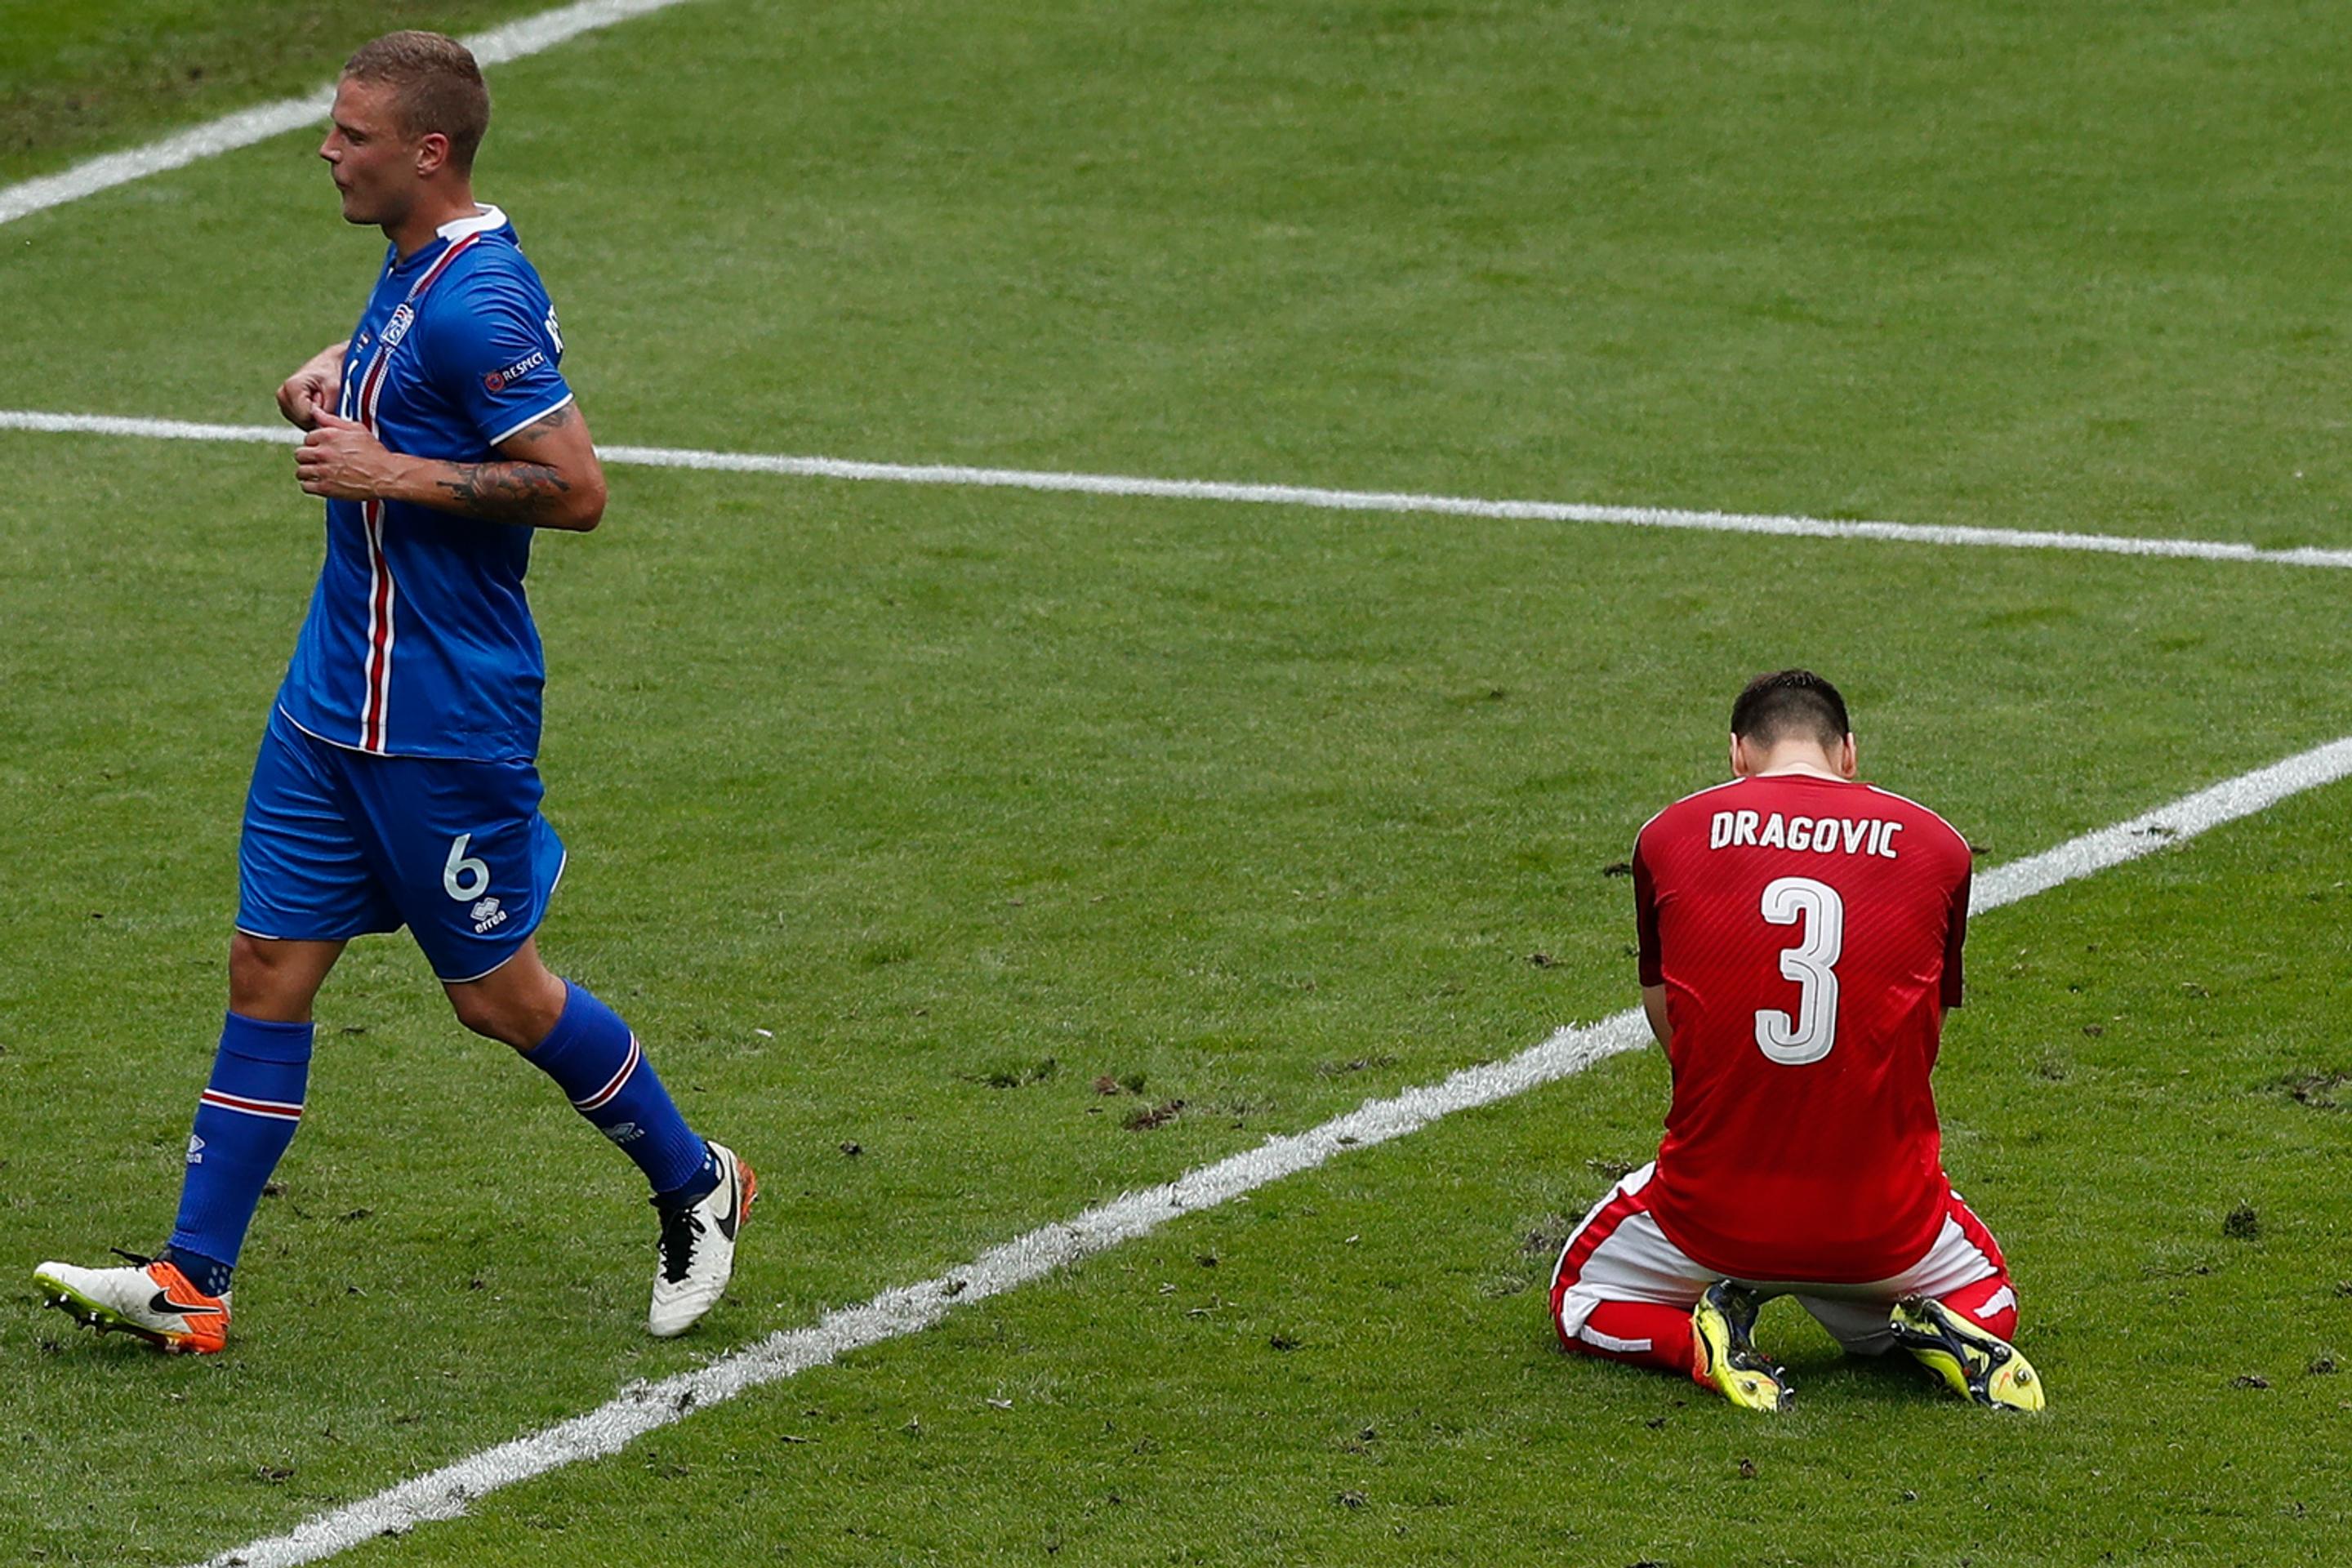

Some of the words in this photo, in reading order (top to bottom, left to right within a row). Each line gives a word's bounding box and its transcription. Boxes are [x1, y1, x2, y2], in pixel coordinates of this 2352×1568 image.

[443, 833, 490, 902] 6
[1710, 810, 1903, 858] DRAGOVIC
[1755, 876, 1844, 1066] 3
